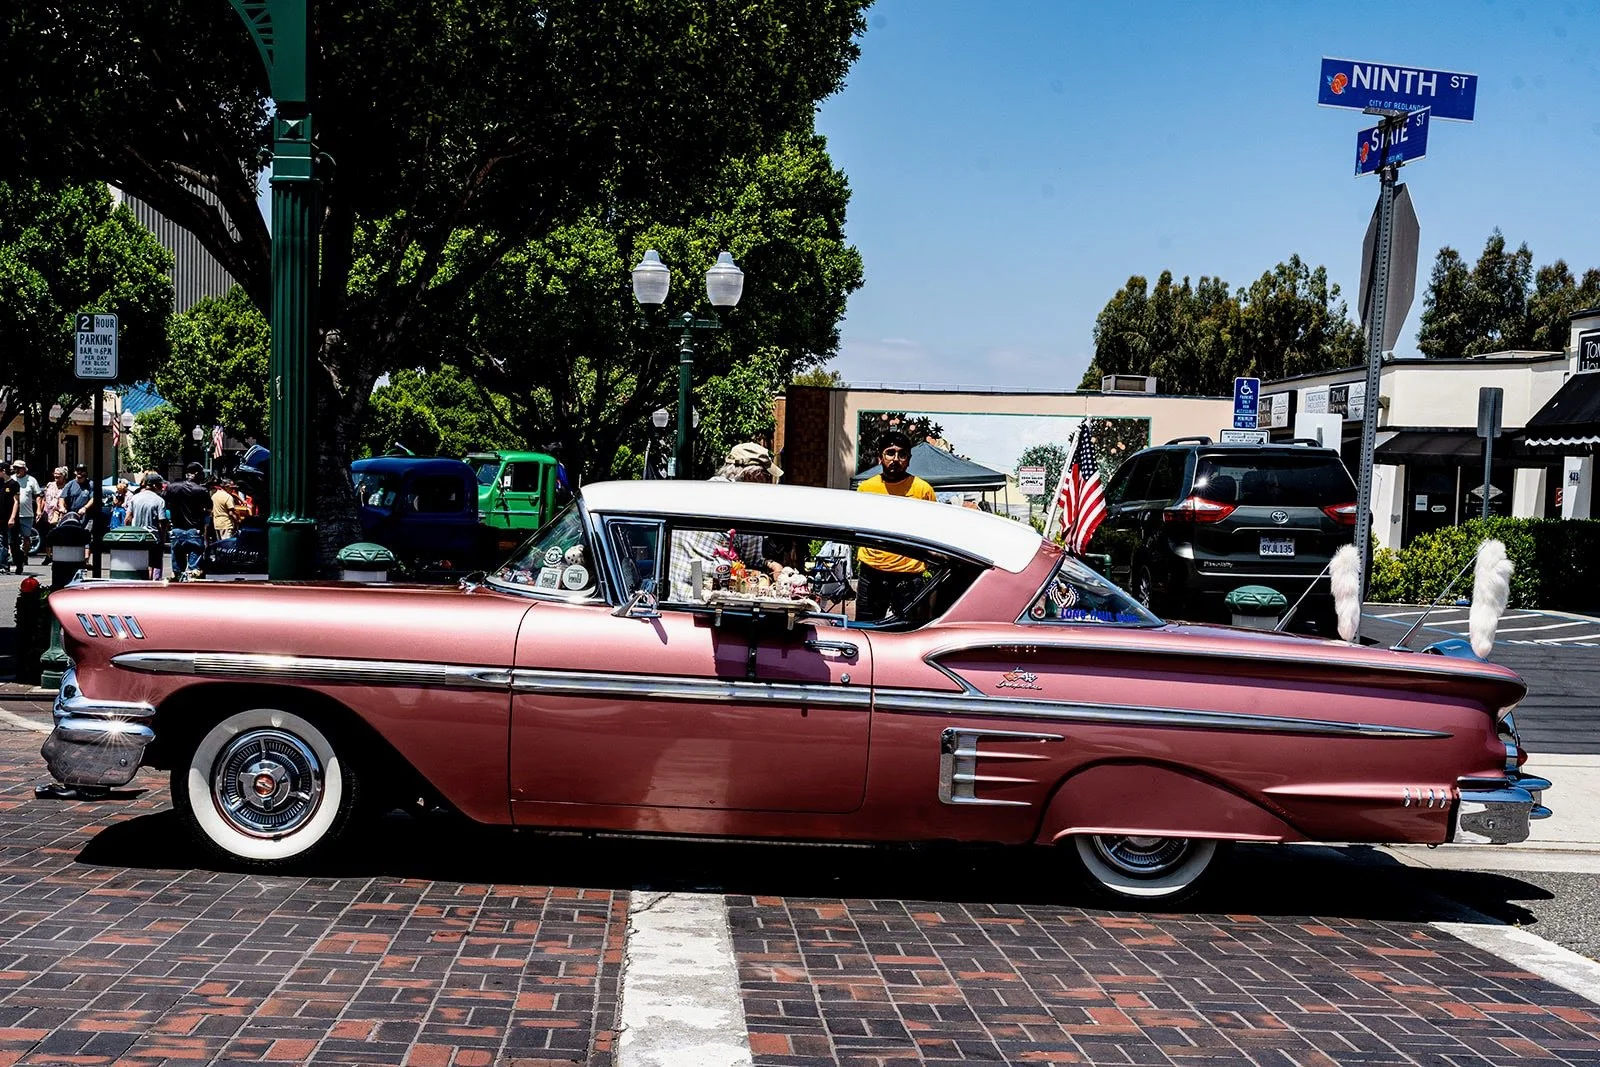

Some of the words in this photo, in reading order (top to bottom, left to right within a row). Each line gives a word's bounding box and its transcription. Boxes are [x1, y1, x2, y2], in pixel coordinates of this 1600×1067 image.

[1351, 64, 1438, 97] NINTH
[1450, 75, 1469, 89] ST
[1369, 99, 1383, 107] CITY
[1371, 118, 1410, 152] STATE
[1416, 112, 1426, 127] ST
[81, 316, 90, 330] 2
[96, 318, 115, 328] HOUR
[79, 333, 113, 346] PARKING
